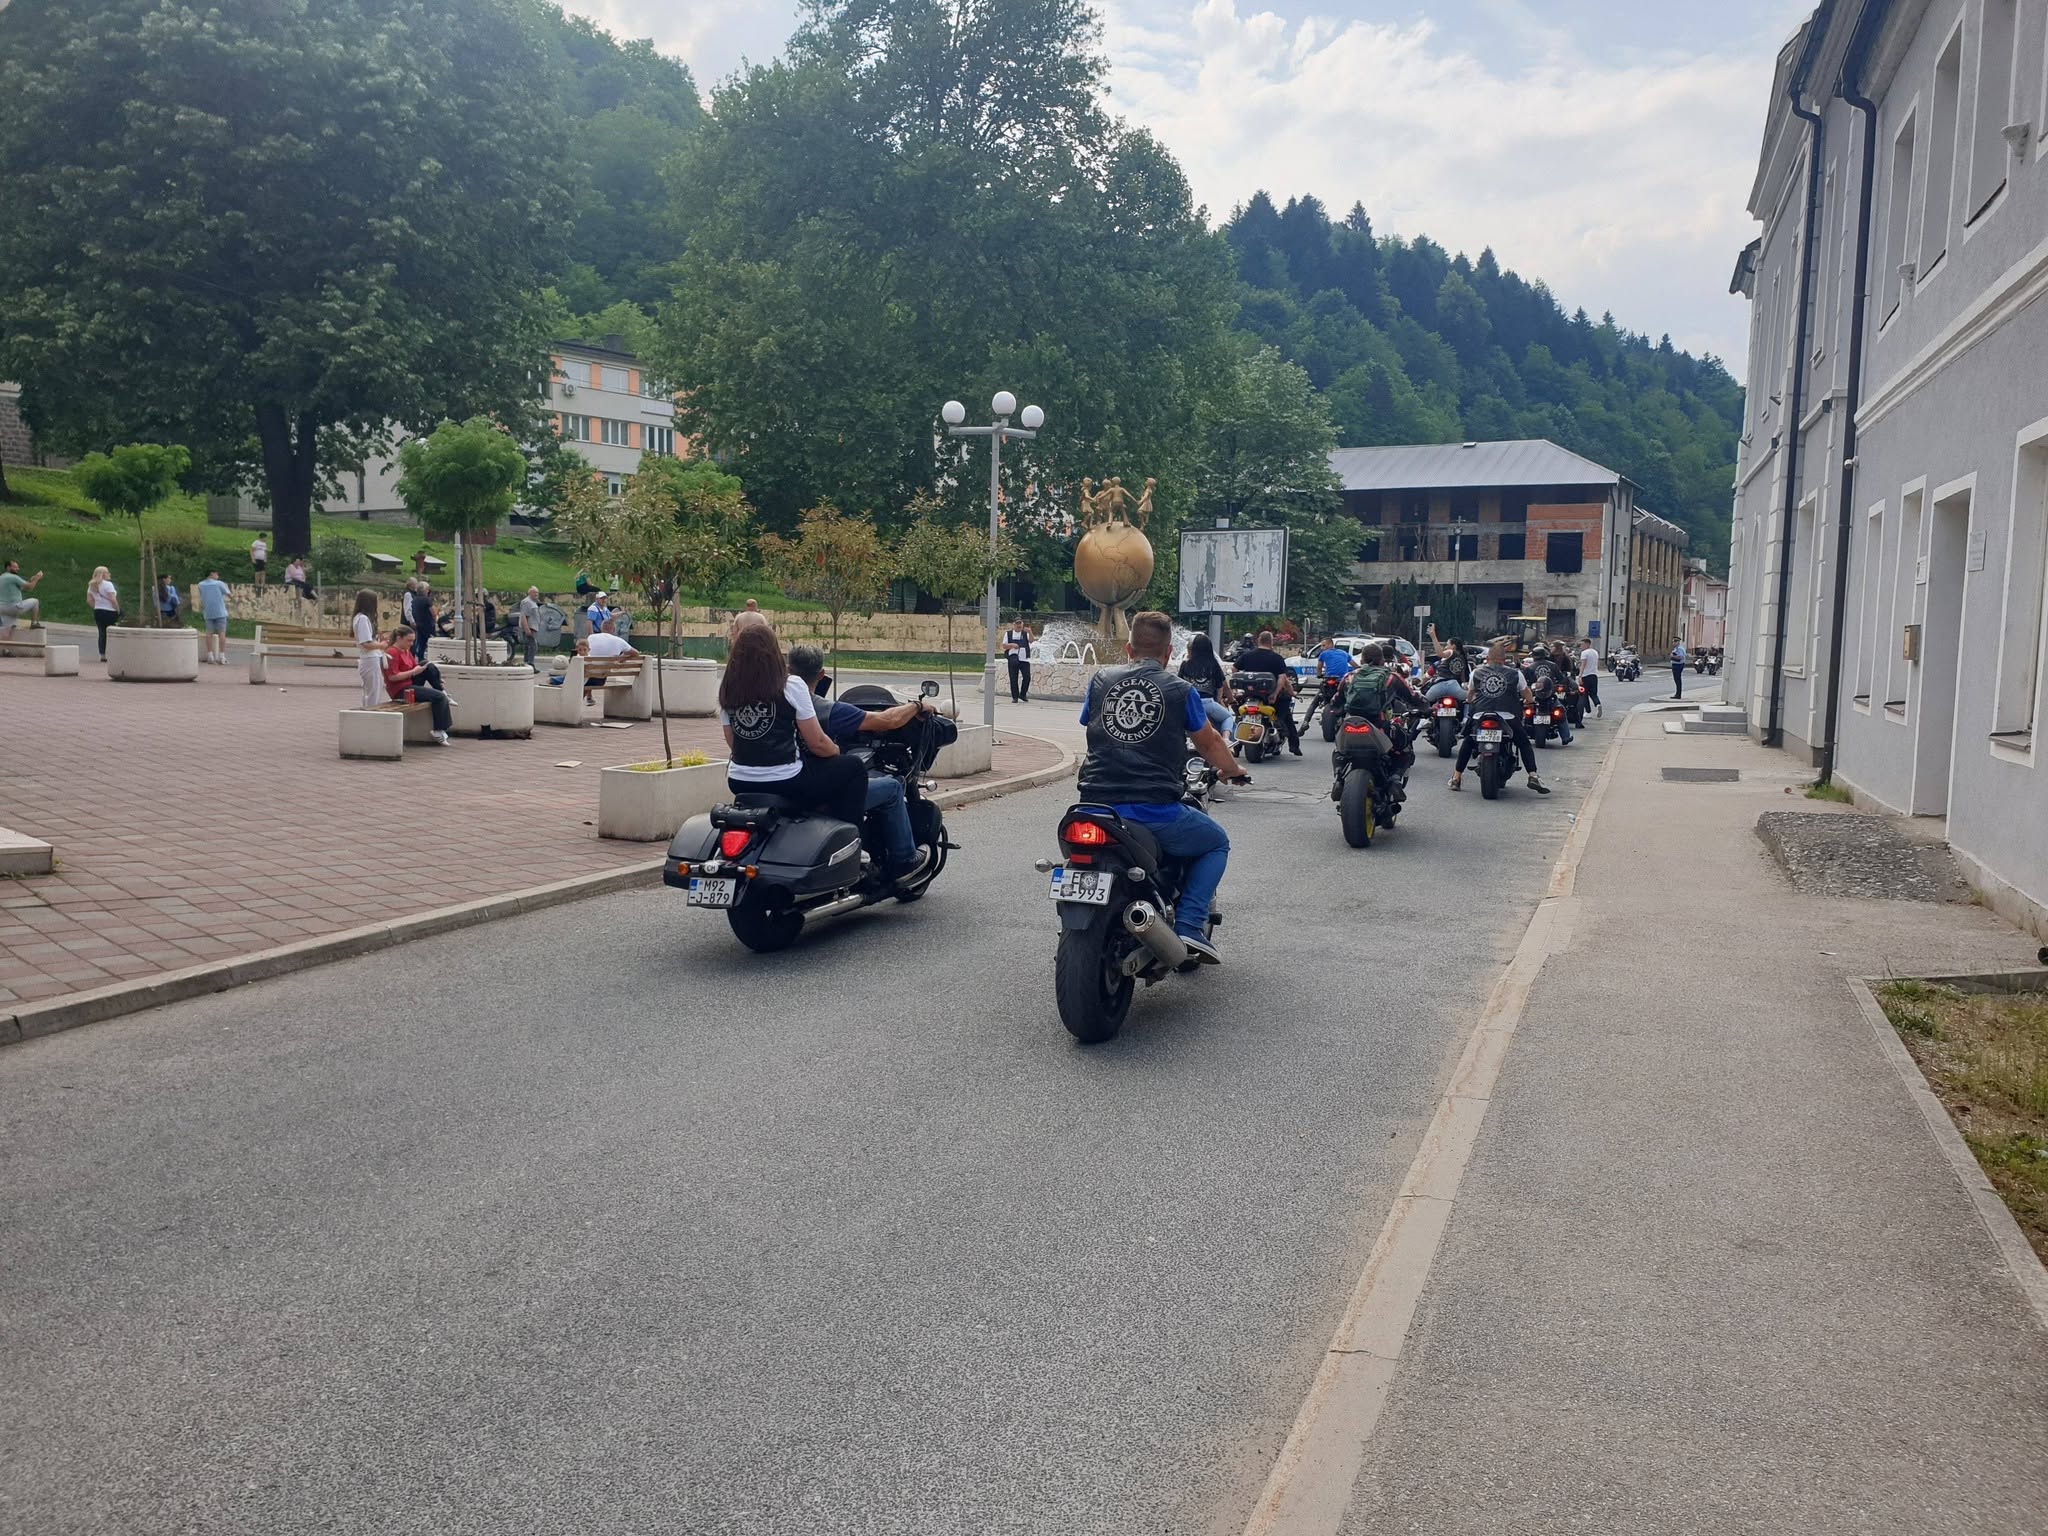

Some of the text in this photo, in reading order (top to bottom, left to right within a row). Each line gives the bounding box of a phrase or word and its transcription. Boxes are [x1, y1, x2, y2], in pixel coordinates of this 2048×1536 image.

[1110, 678, 1161, 702] ARGENTUM
[1125, 701, 1156, 716] AG
[1106, 715, 1155, 740] SREBRENICA
[704, 880, 725, 892] M92
